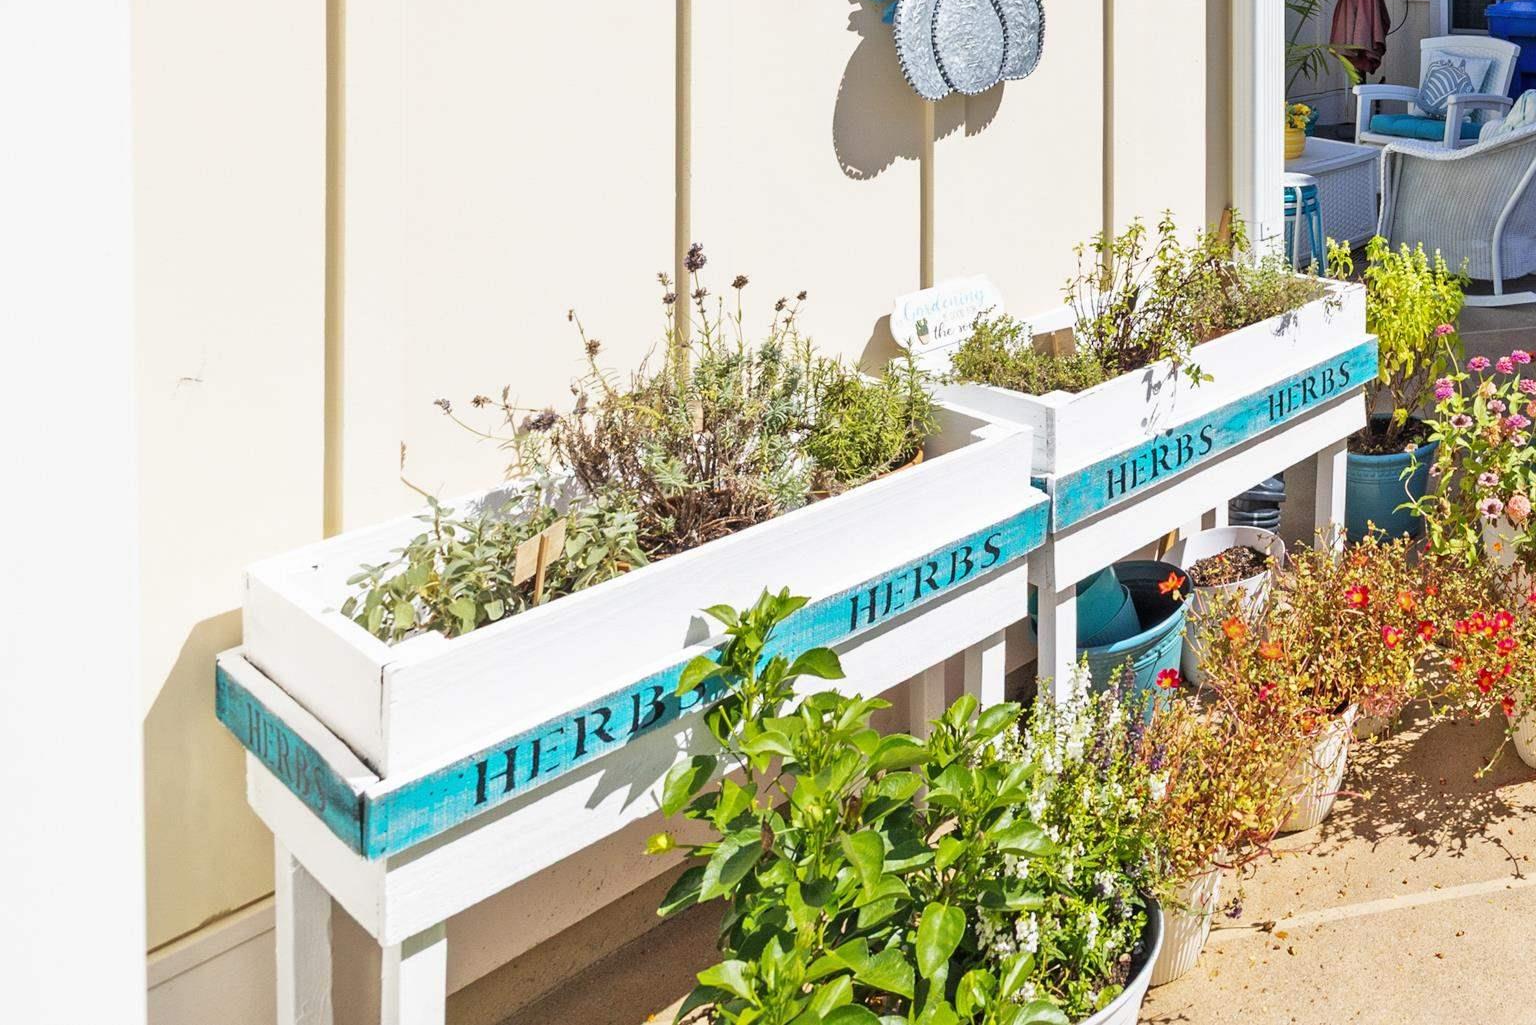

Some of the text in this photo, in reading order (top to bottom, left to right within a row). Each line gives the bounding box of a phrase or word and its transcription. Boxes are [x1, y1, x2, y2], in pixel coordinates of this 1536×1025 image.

[1107, 361, 1350, 500] HERBS HERBS
[850, 532, 1001, 632] HERBS
[246, 702, 328, 813] HERBS
